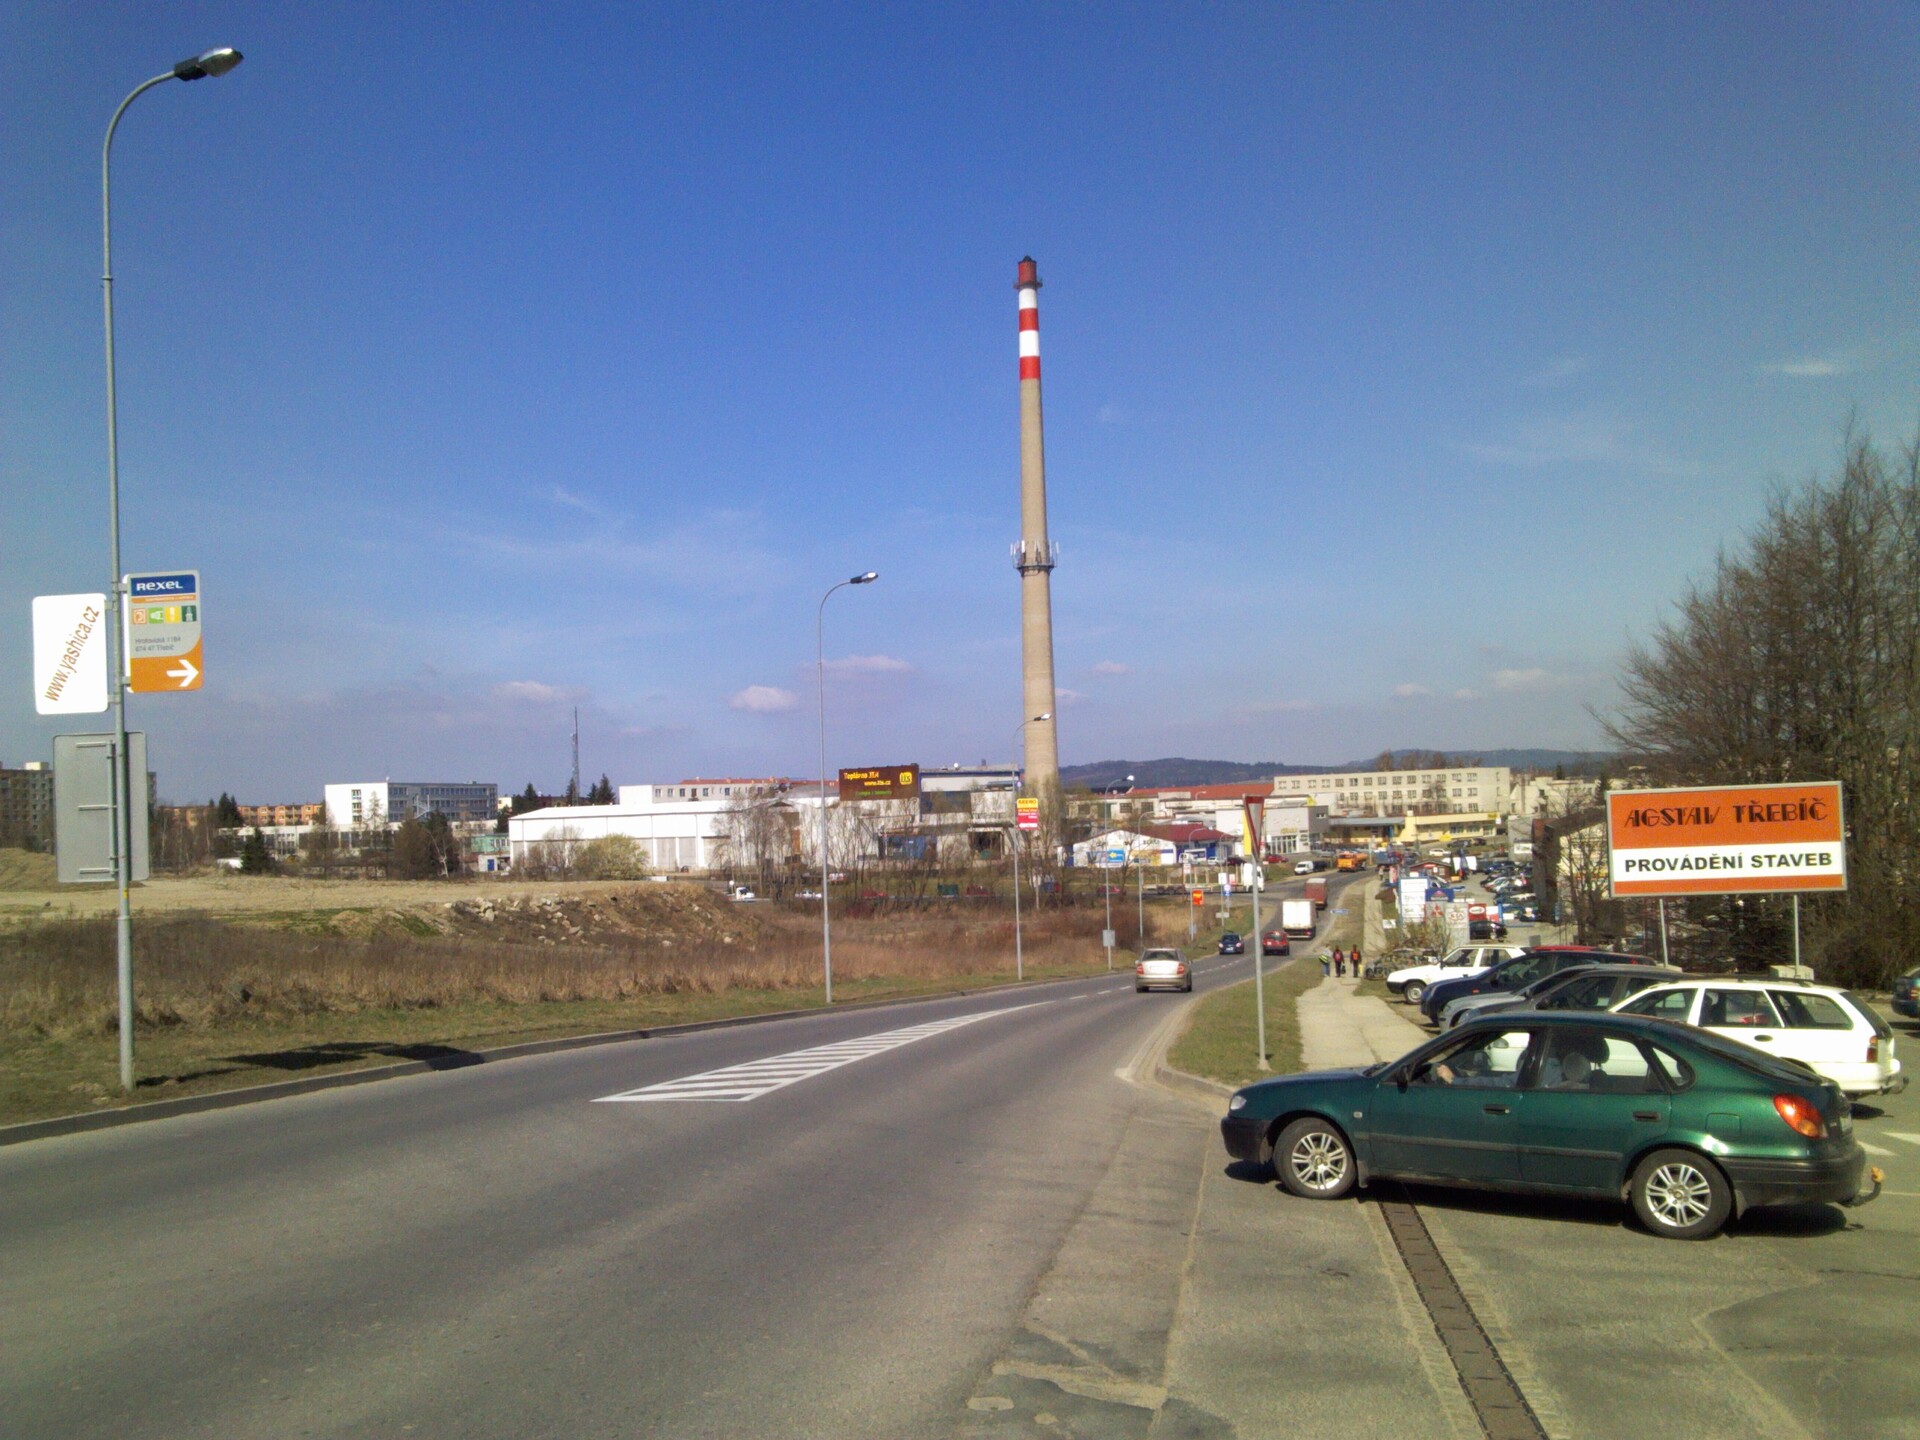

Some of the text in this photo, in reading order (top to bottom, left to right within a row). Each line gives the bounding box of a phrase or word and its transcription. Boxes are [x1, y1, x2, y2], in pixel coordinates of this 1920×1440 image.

[44, 605, 100, 702] www.yashica.cz
[1624, 797, 1828, 828] AGSTAV TŘEBÍČ
[1624, 852, 1833, 873] PROVÁDĚNÍ STAVEB
